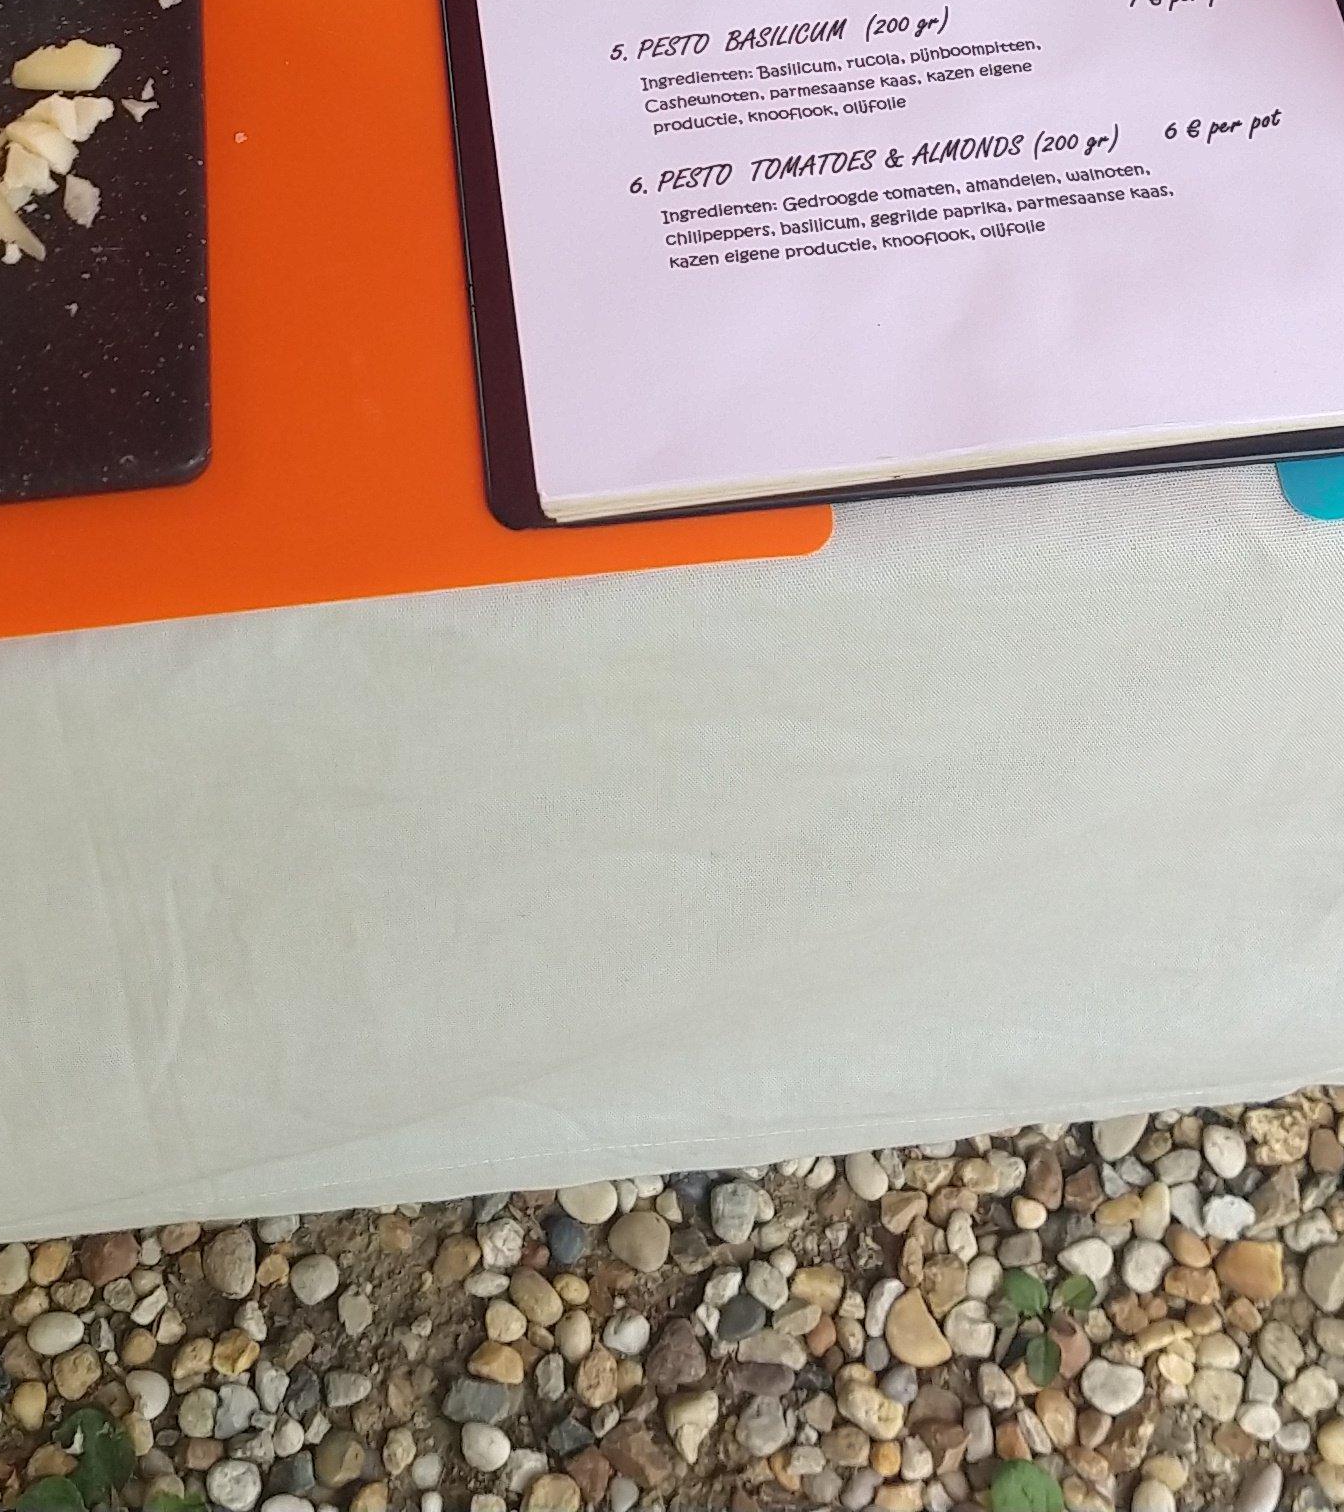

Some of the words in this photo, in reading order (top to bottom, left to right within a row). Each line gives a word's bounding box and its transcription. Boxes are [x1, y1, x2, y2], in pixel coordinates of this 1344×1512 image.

[610, 44, 627, 61] 5.
[637, 33, 710, 59] PESTO
[725, 18, 847, 51] BASILICUM
[866, 14, 909, 42] (200
[914, 6, 948, 37] gr)
[640, 70, 753, 91] Ingredienten:
[756, 61, 842, 79] Basilicum,
[846, 53, 905, 68] rucola,
[910, 41, 1041, 63] pijnboompitten,
[645, 91, 765, 113] Cashewnoten,
[770, 79, 875, 100] parmesaanse
[880, 75, 921, 87] kaas,
[927, 68, 974, 82] kazen
[979, 62, 1032, 76] eigene
[630, 177, 647, 194] 6.
[658, 163, 732, 192] PESTO
[751, 150, 876, 181] TOMATOES
[912, 135, 1024, 166] ALMONDS
[1034, 131, 1079, 160] (200
[1084, 123, 1118, 156] gr)
[661, 202, 777, 224] Ingredienten:
[783, 190, 878, 211] Gedroogde
[882, 184, 960, 200] tomaten,
[966, 174, 1061, 192] amandelen,
[1066, 166, 1150, 181] walnoten,
[666, 225, 775, 246] chilipeppers,
[780, 217, 865, 235] basilicum,
[871, 208, 937, 227] gegrilde
[943, 202, 1012, 220] paprika,
[1017, 190, 1125, 212] parmesaanse
[1130, 186, 1174, 199] kaas,
